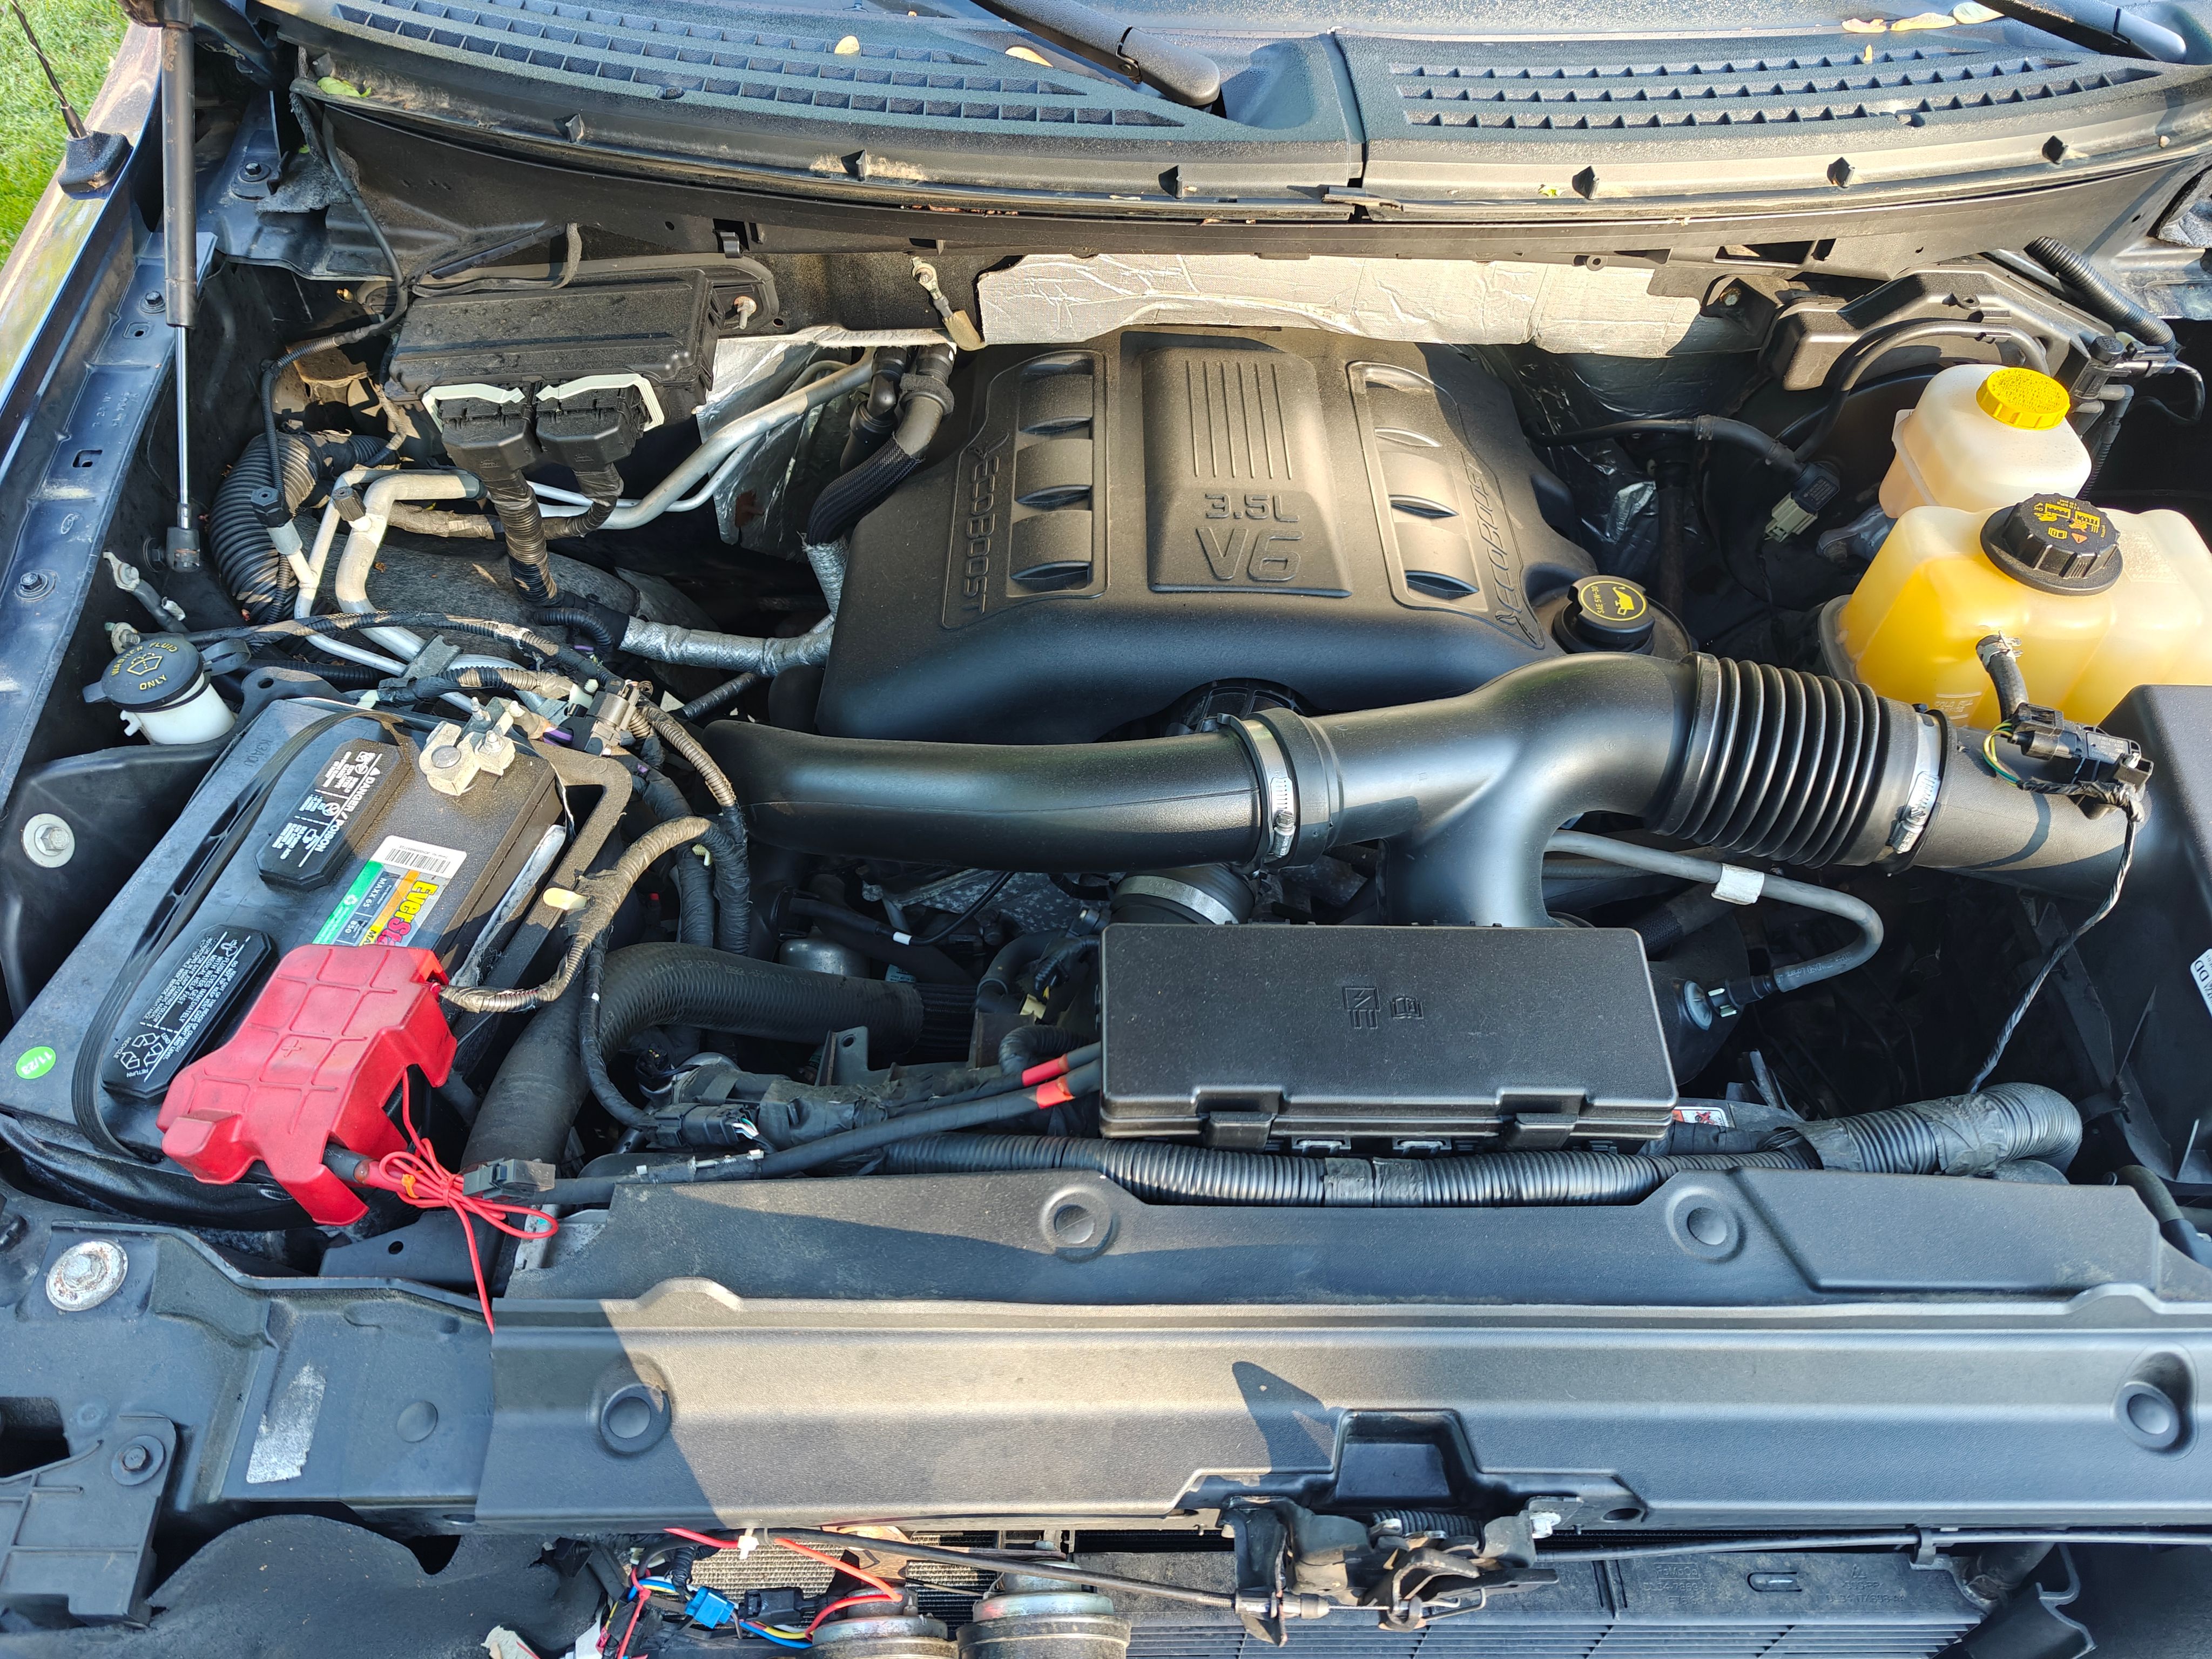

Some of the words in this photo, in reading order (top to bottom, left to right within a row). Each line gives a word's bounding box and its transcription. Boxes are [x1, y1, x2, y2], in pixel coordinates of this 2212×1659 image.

[1205, 494, 1300, 522] 3.5L
[962, 456, 999, 615] ECOBOOST
[1460, 450, 1522, 613] ECOBOOST
[1196, 526, 1304, 583] V6
[1591, 586, 1602, 603] 5W-30
[1595, 603, 1604, 614] SAE
[149, 642, 178, 653] FLUID
[139, 674, 167, 690] ONLY
[343, 775, 376, 812] DANGER
[314, 818, 345, 852] POISON
[368, 878, 388, 898] MAXX
[361, 898, 374, 908] 65
[343, 920, 358, 933] 850
[361, 929, 377, 946] MA
[196, 955, 206, 963] FOR
[197, 954, 218, 976] MEDICAL
[210, 955, 224, 969] WITH
[213, 957, 230, 974] FLUSH
[188, 963, 199, 974] SAFE
[223, 967, 233, 977] NOT
[186, 976, 201, 990] HELP
[203, 974, 218, 988] EYES
[218, 981, 229, 991] OUT
[164, 986, 183, 1005] STARTING
[176, 990, 191, 1004] FAST
[186, 989, 199, 1000] GET
[207, 986, 220, 998] KEEP
[177, 988, 207, 1023] IMMEDIATELY
[199, 998, 211, 1009] VENT
[206, 999, 216, 1008] THE
[151, 1005, 168, 1023] FOLLOW
[190, 1009, 203, 1022] CAPS
[195, 1008, 210, 1022] REACH
[180, 1022, 193, 1036] TIGHT
[113, 1037, 132, 1058] RECYCLE
[172, 1035, 184, 1046] AND
[21, 1051, 52, 1075] 11/23
[126, 1069, 149, 1078] RETURN
